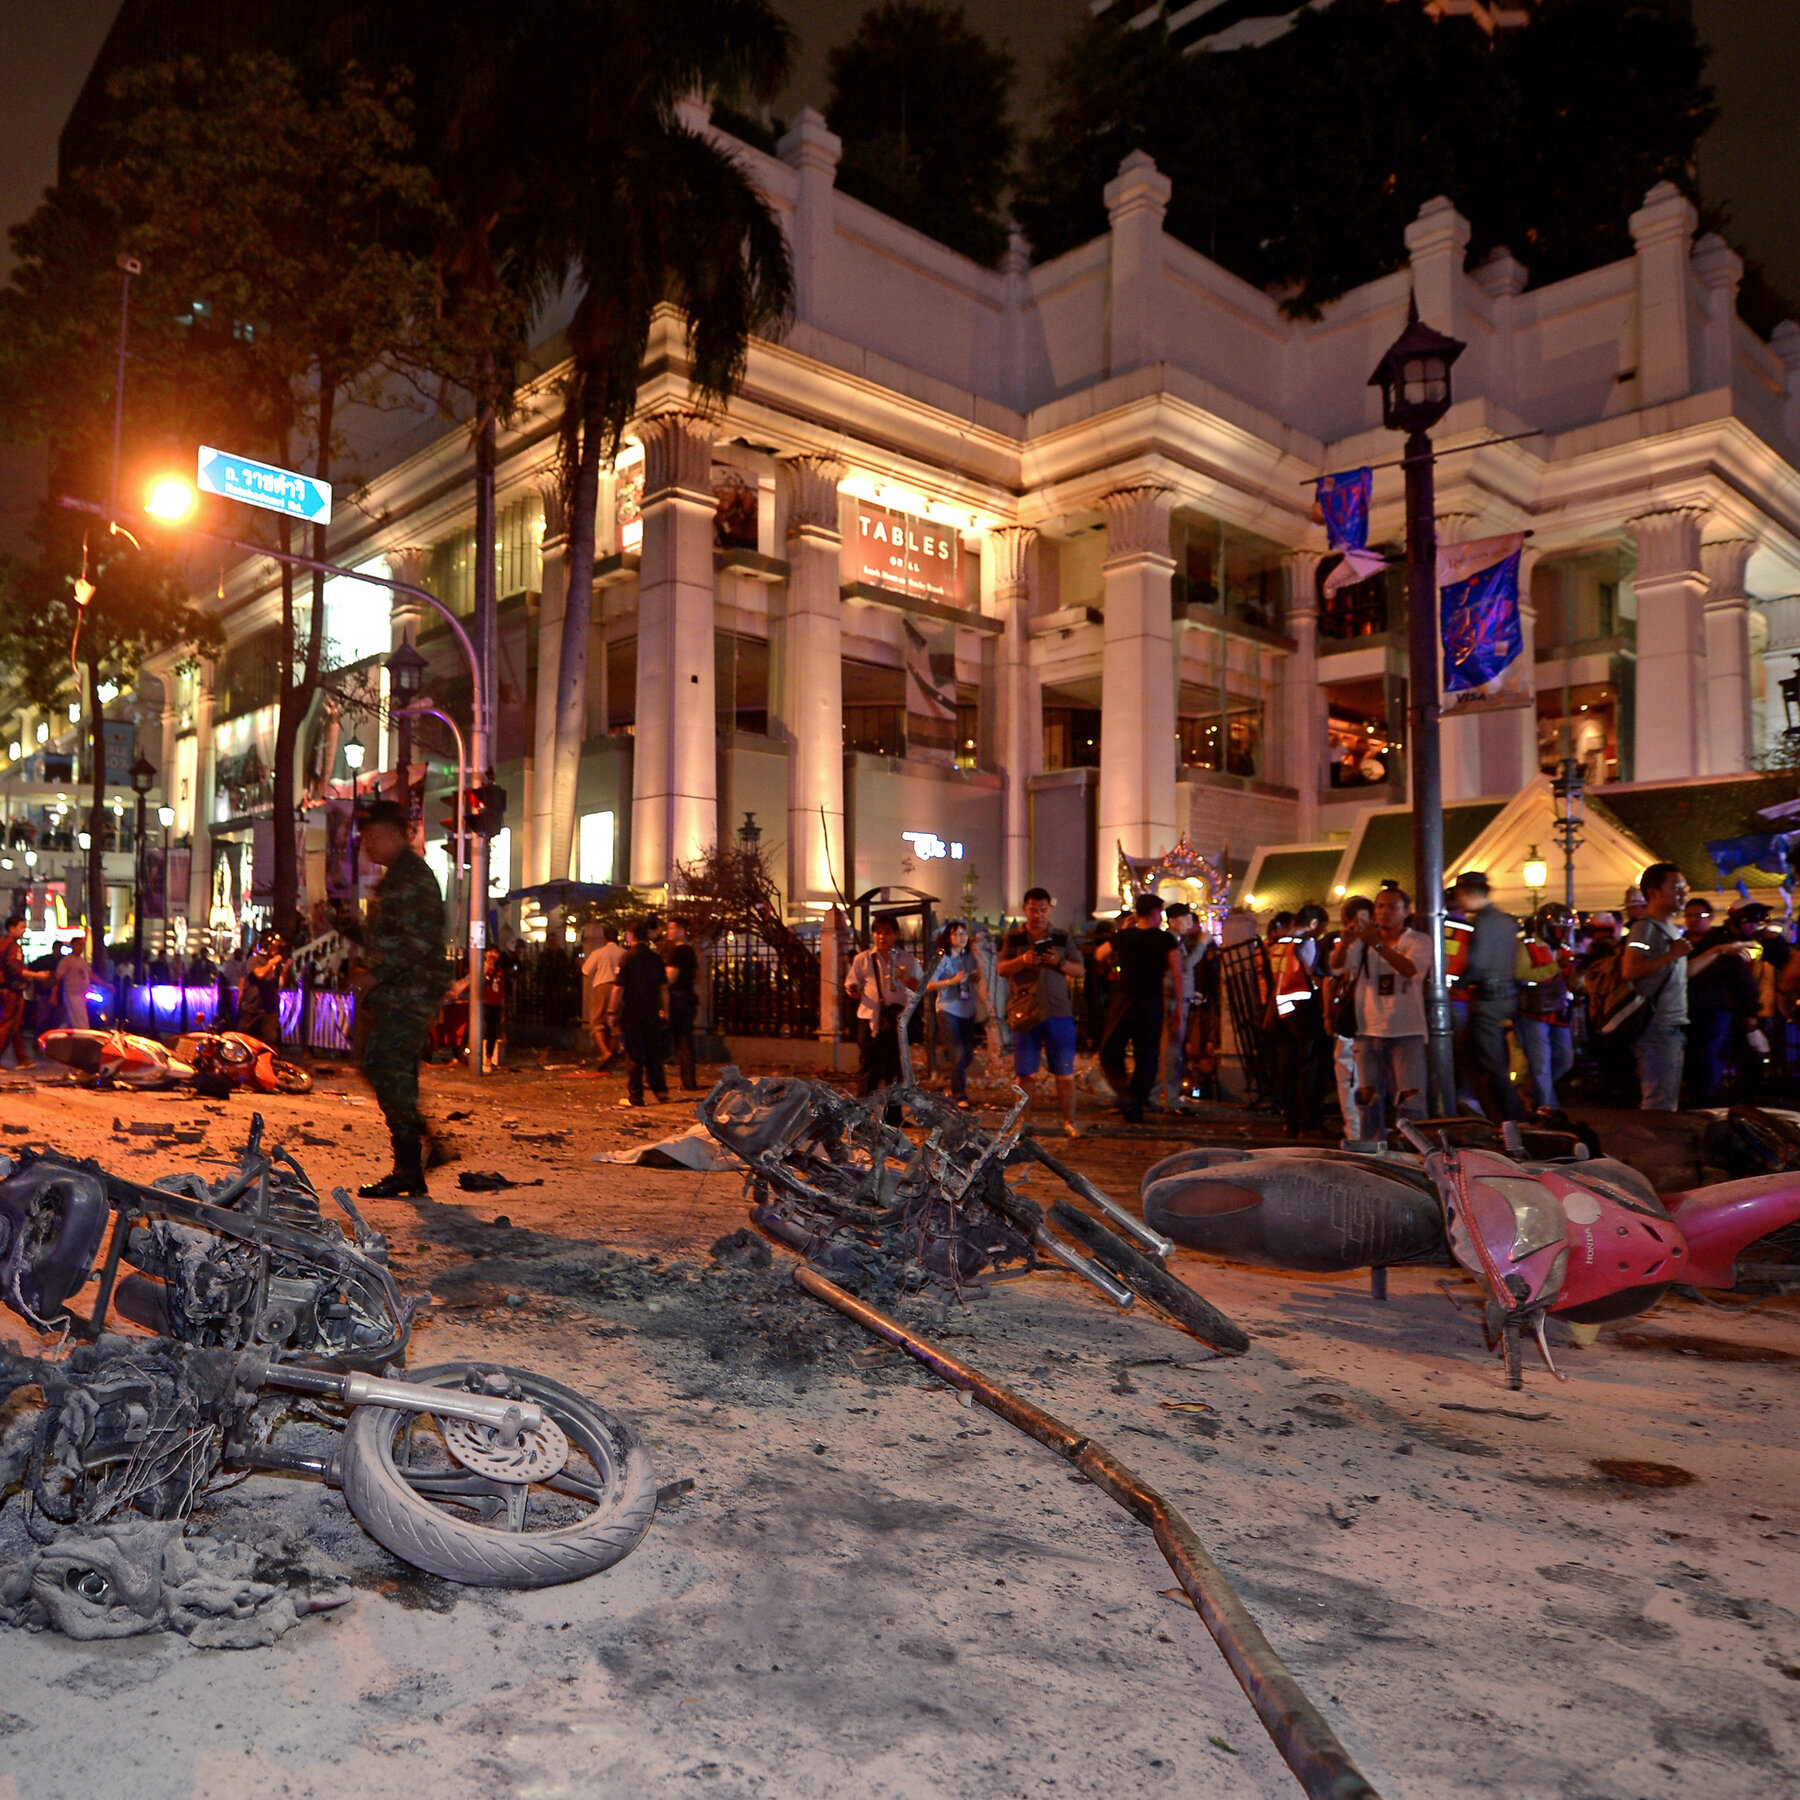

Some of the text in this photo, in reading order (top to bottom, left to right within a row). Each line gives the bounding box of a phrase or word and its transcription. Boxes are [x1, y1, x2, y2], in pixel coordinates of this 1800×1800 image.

[859, 515, 950, 560] TABLES
[1456, 692, 1487, 703] VISA
[1584, 1227, 1595, 1265] HONDA
